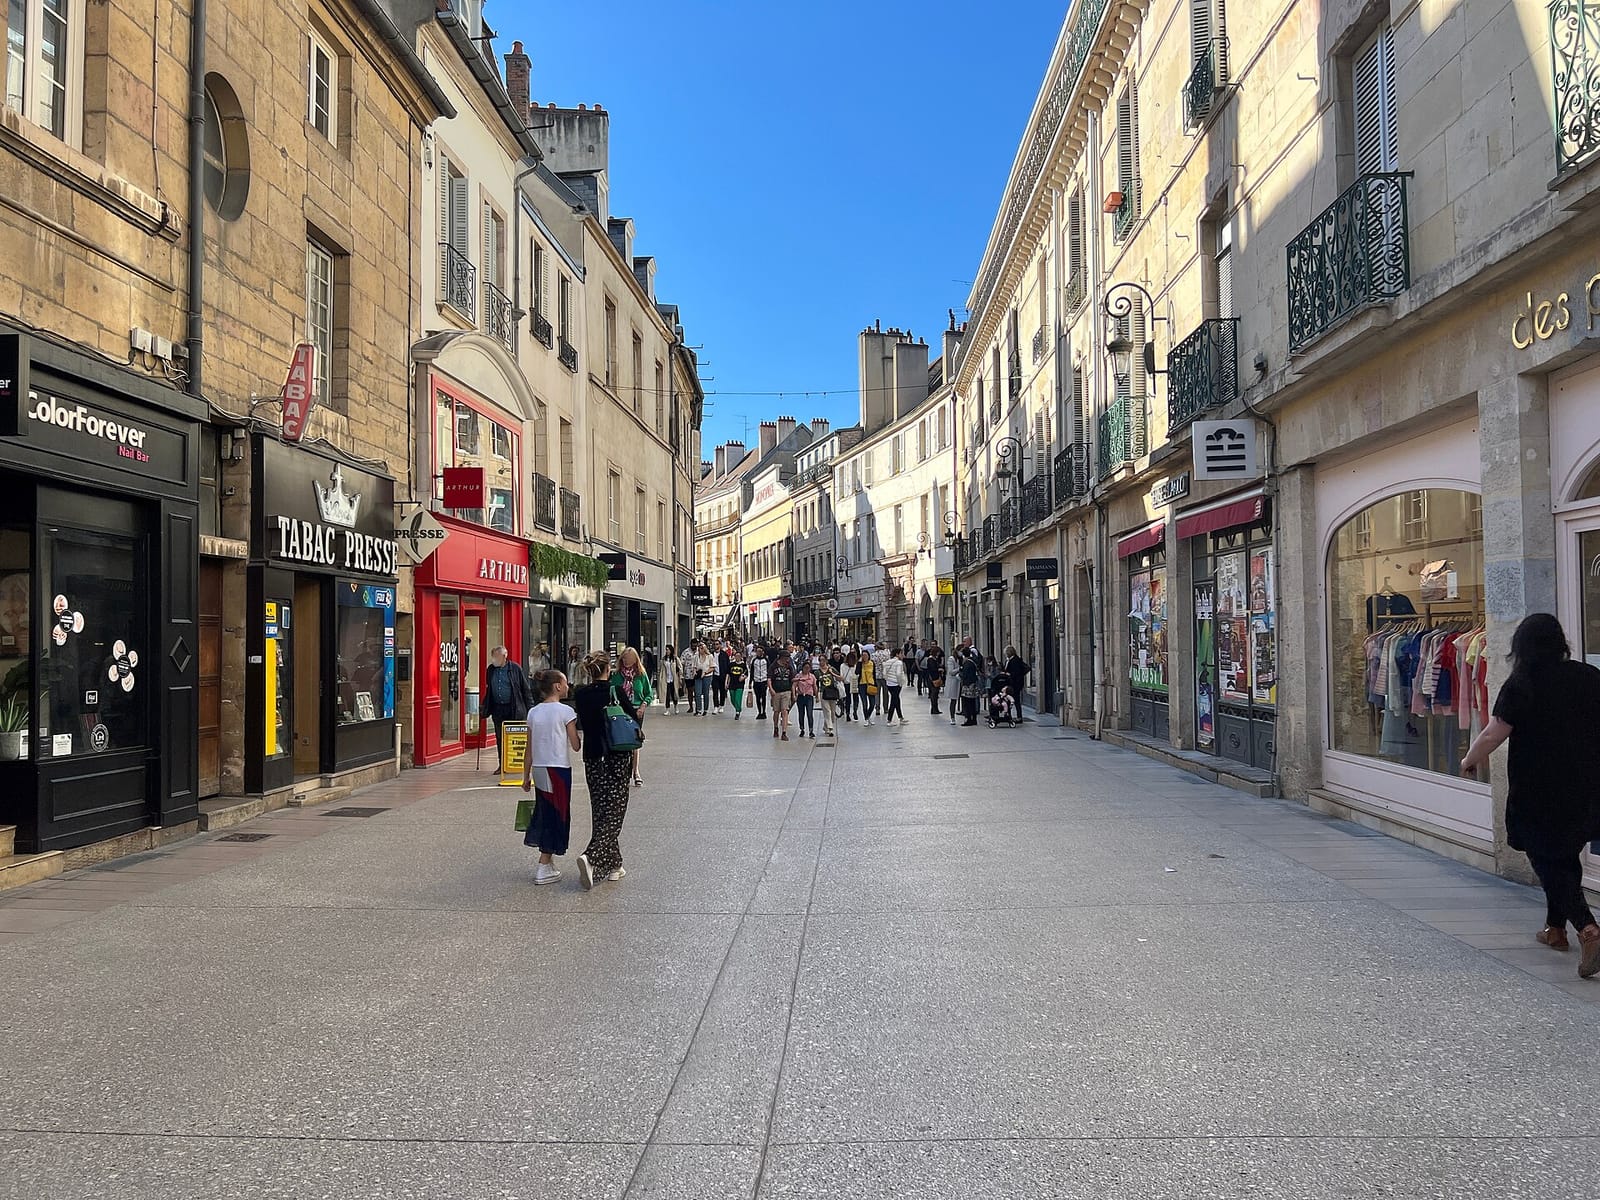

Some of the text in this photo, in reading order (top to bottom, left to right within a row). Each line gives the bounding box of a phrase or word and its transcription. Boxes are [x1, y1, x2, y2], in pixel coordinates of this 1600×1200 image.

[1512, 291, 1570, 349] des
[283, 346, 306, 436] TABAC
[119, 446, 150, 462] Nail Bar
[278, 515, 399, 575] TABAC PRESSE
[394, 529, 444, 539] PRESSE
[480, 558, 527, 585] ARTHUR
